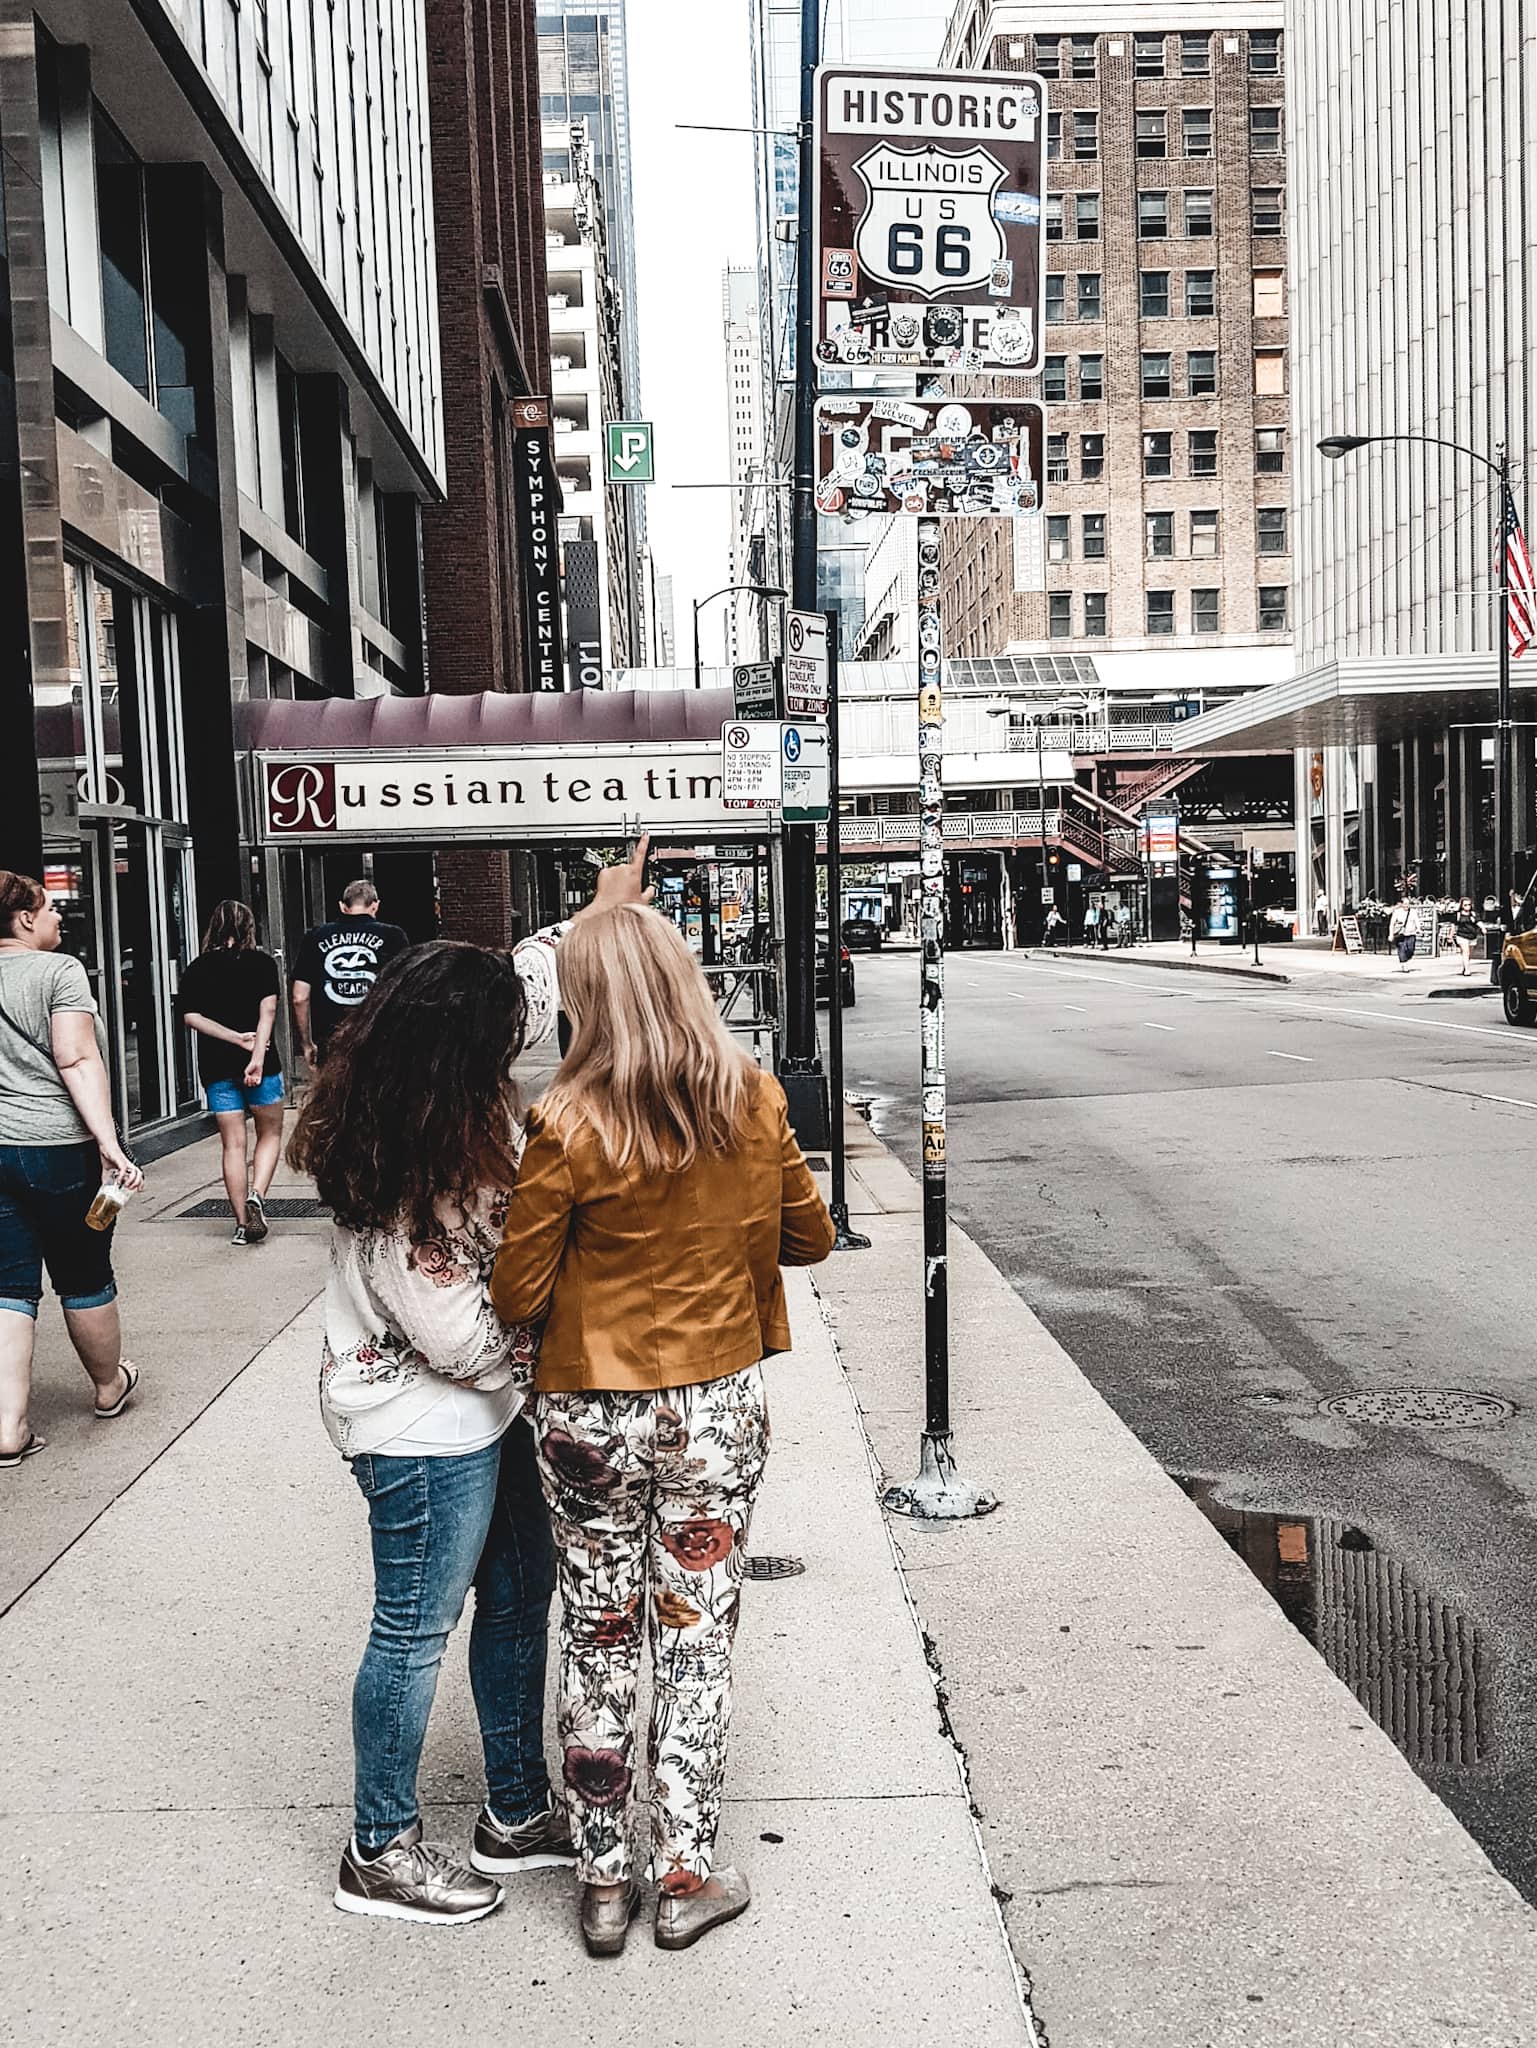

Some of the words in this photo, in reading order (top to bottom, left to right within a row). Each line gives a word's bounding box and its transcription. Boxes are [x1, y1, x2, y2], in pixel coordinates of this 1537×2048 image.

[843, 90, 1017, 130] HISTORIC
[879, 161, 983, 184] ILLINOIS
[906, 197, 922, 219] U
[939, 199, 955, 220] S
[888, 223, 971, 277] 66
[830, 261, 850, 276] 66
[527, 440, 548, 577] SYMPHONY
[536, 590, 556, 691] CENTER
[789, 697, 804, 710] TOW
[806, 699, 826, 713] ZONE
[784, 770, 811, 780] RESERVED
[270, 764, 525, 828] Russian
[543, 771, 628, 803] tea
[644, 767, 723, 802] tim
[728, 800, 748, 808] TOW
[753, 800, 780, 808] ZONE
[318, 932, 384, 953] CLEARWATER
[337, 982, 369, 995] BEACH
[924, 1135, 945, 1151] Au
